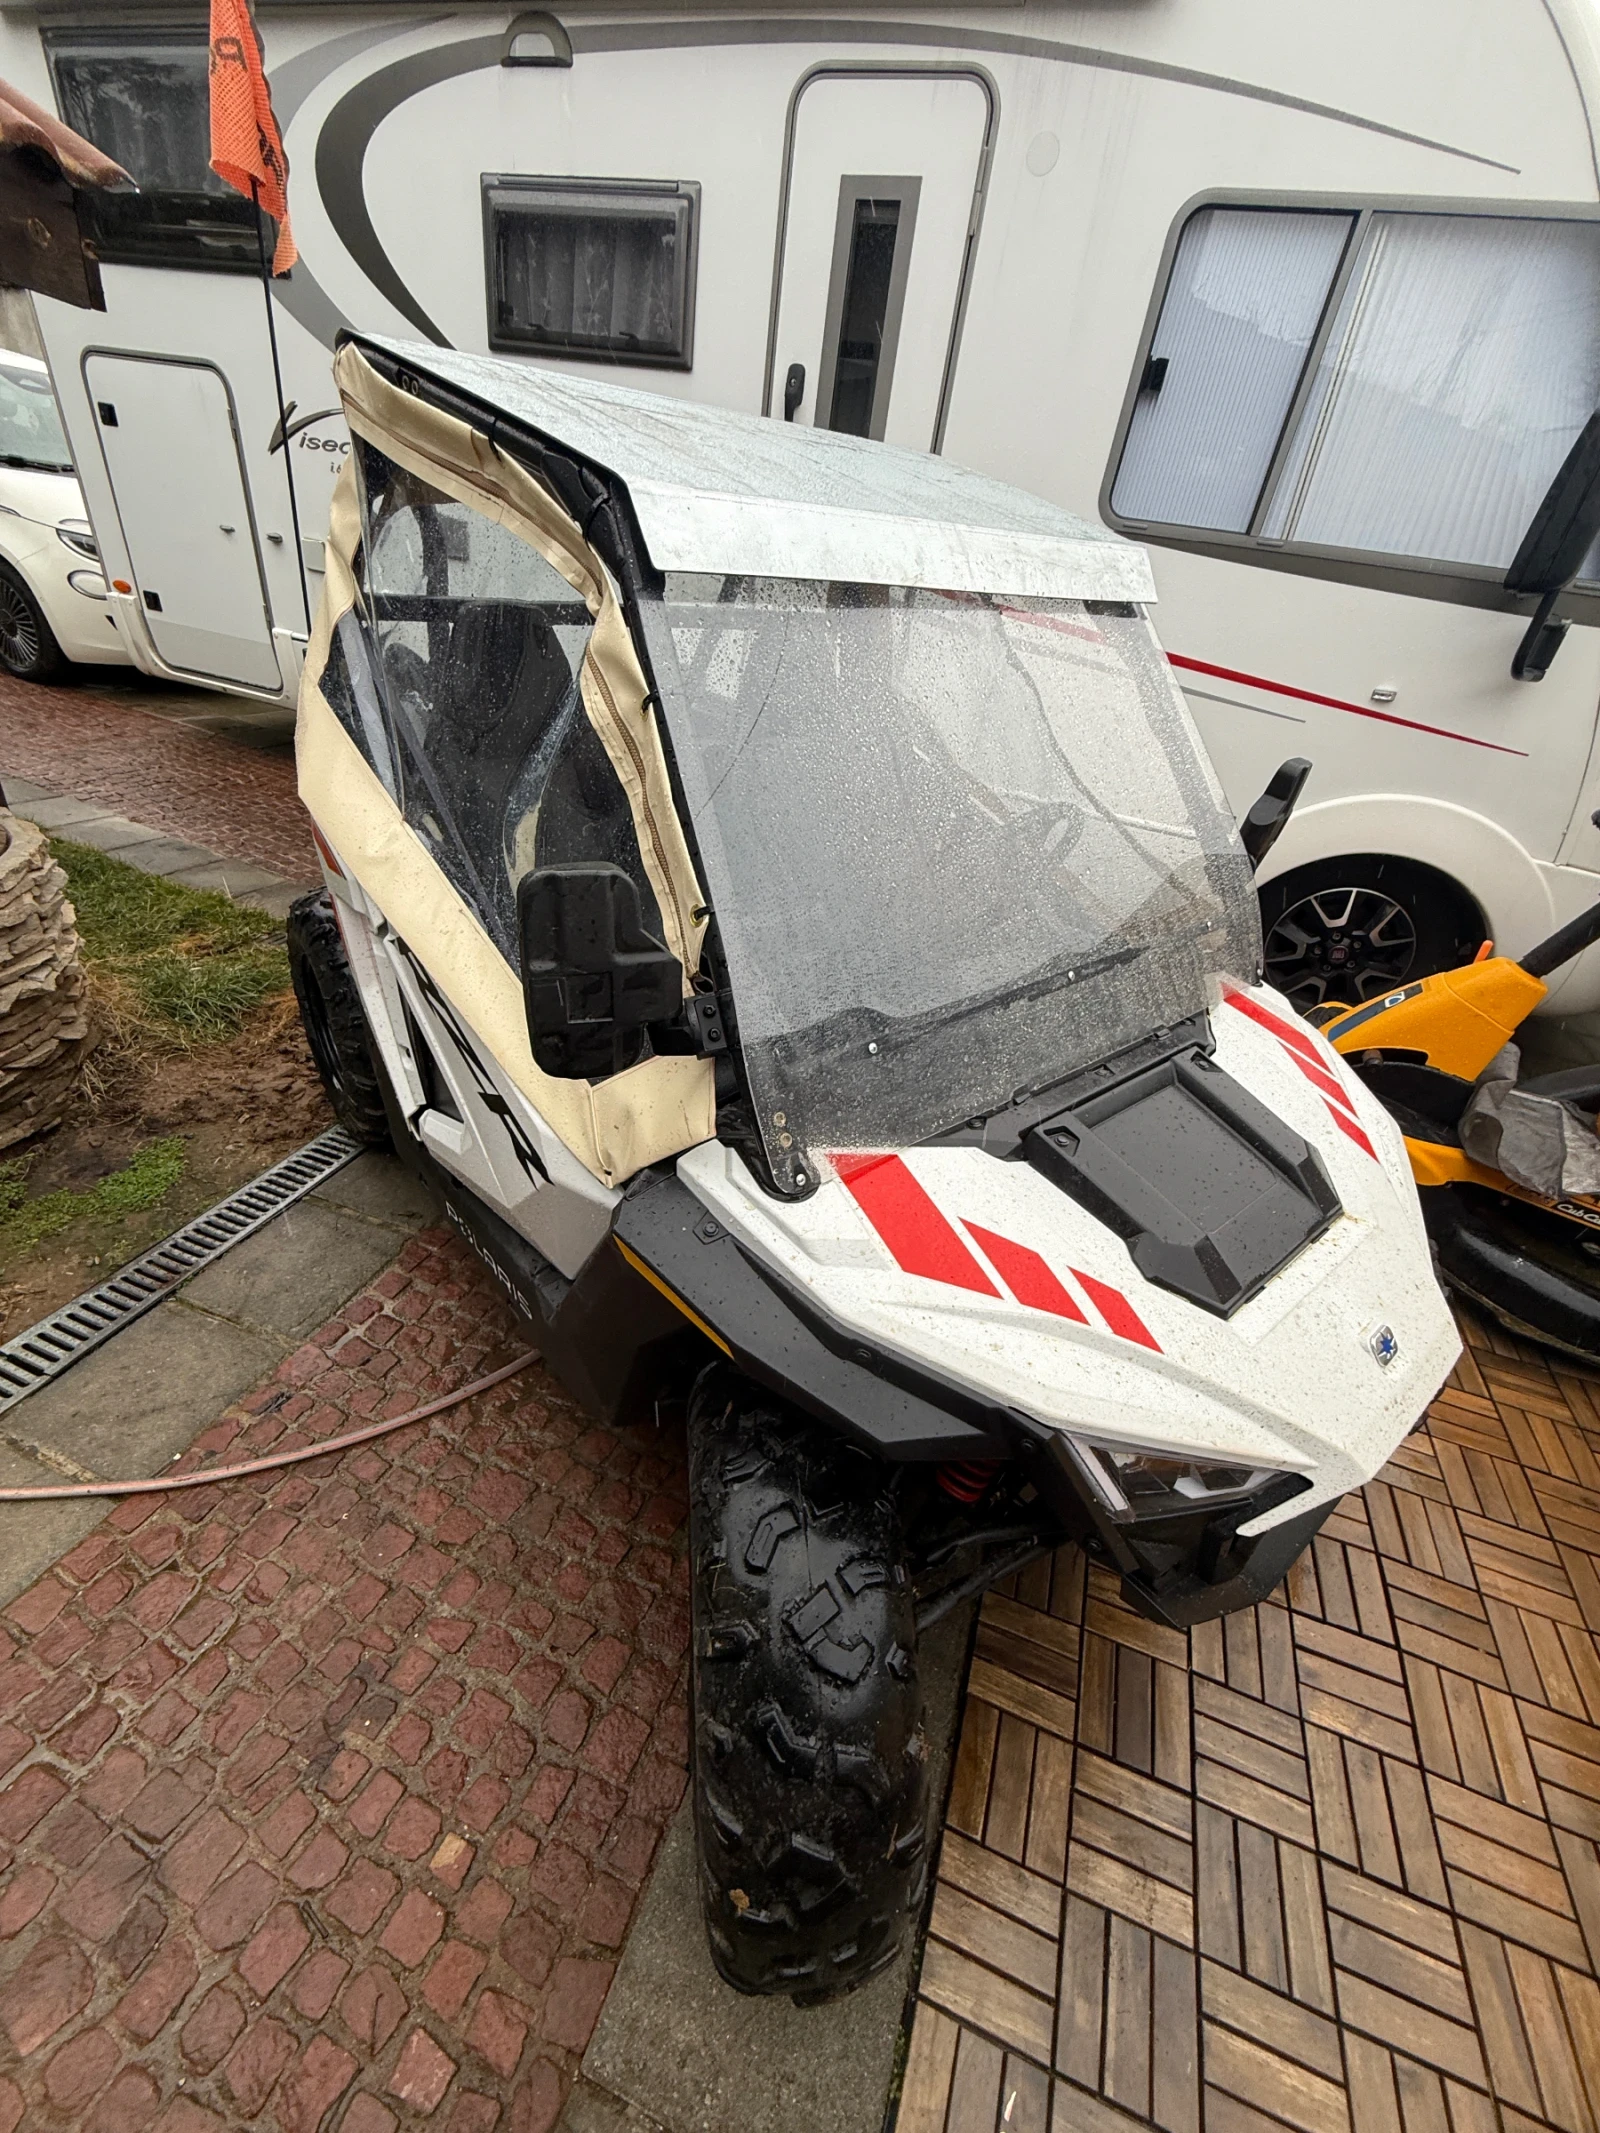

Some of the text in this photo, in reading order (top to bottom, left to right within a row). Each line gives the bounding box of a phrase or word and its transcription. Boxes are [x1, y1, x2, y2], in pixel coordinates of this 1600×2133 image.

[394, 936, 556, 1192] RZR
[445, 1200, 533, 1320] POLARIS
[1557, 1204, 1584, 1217] Cub
